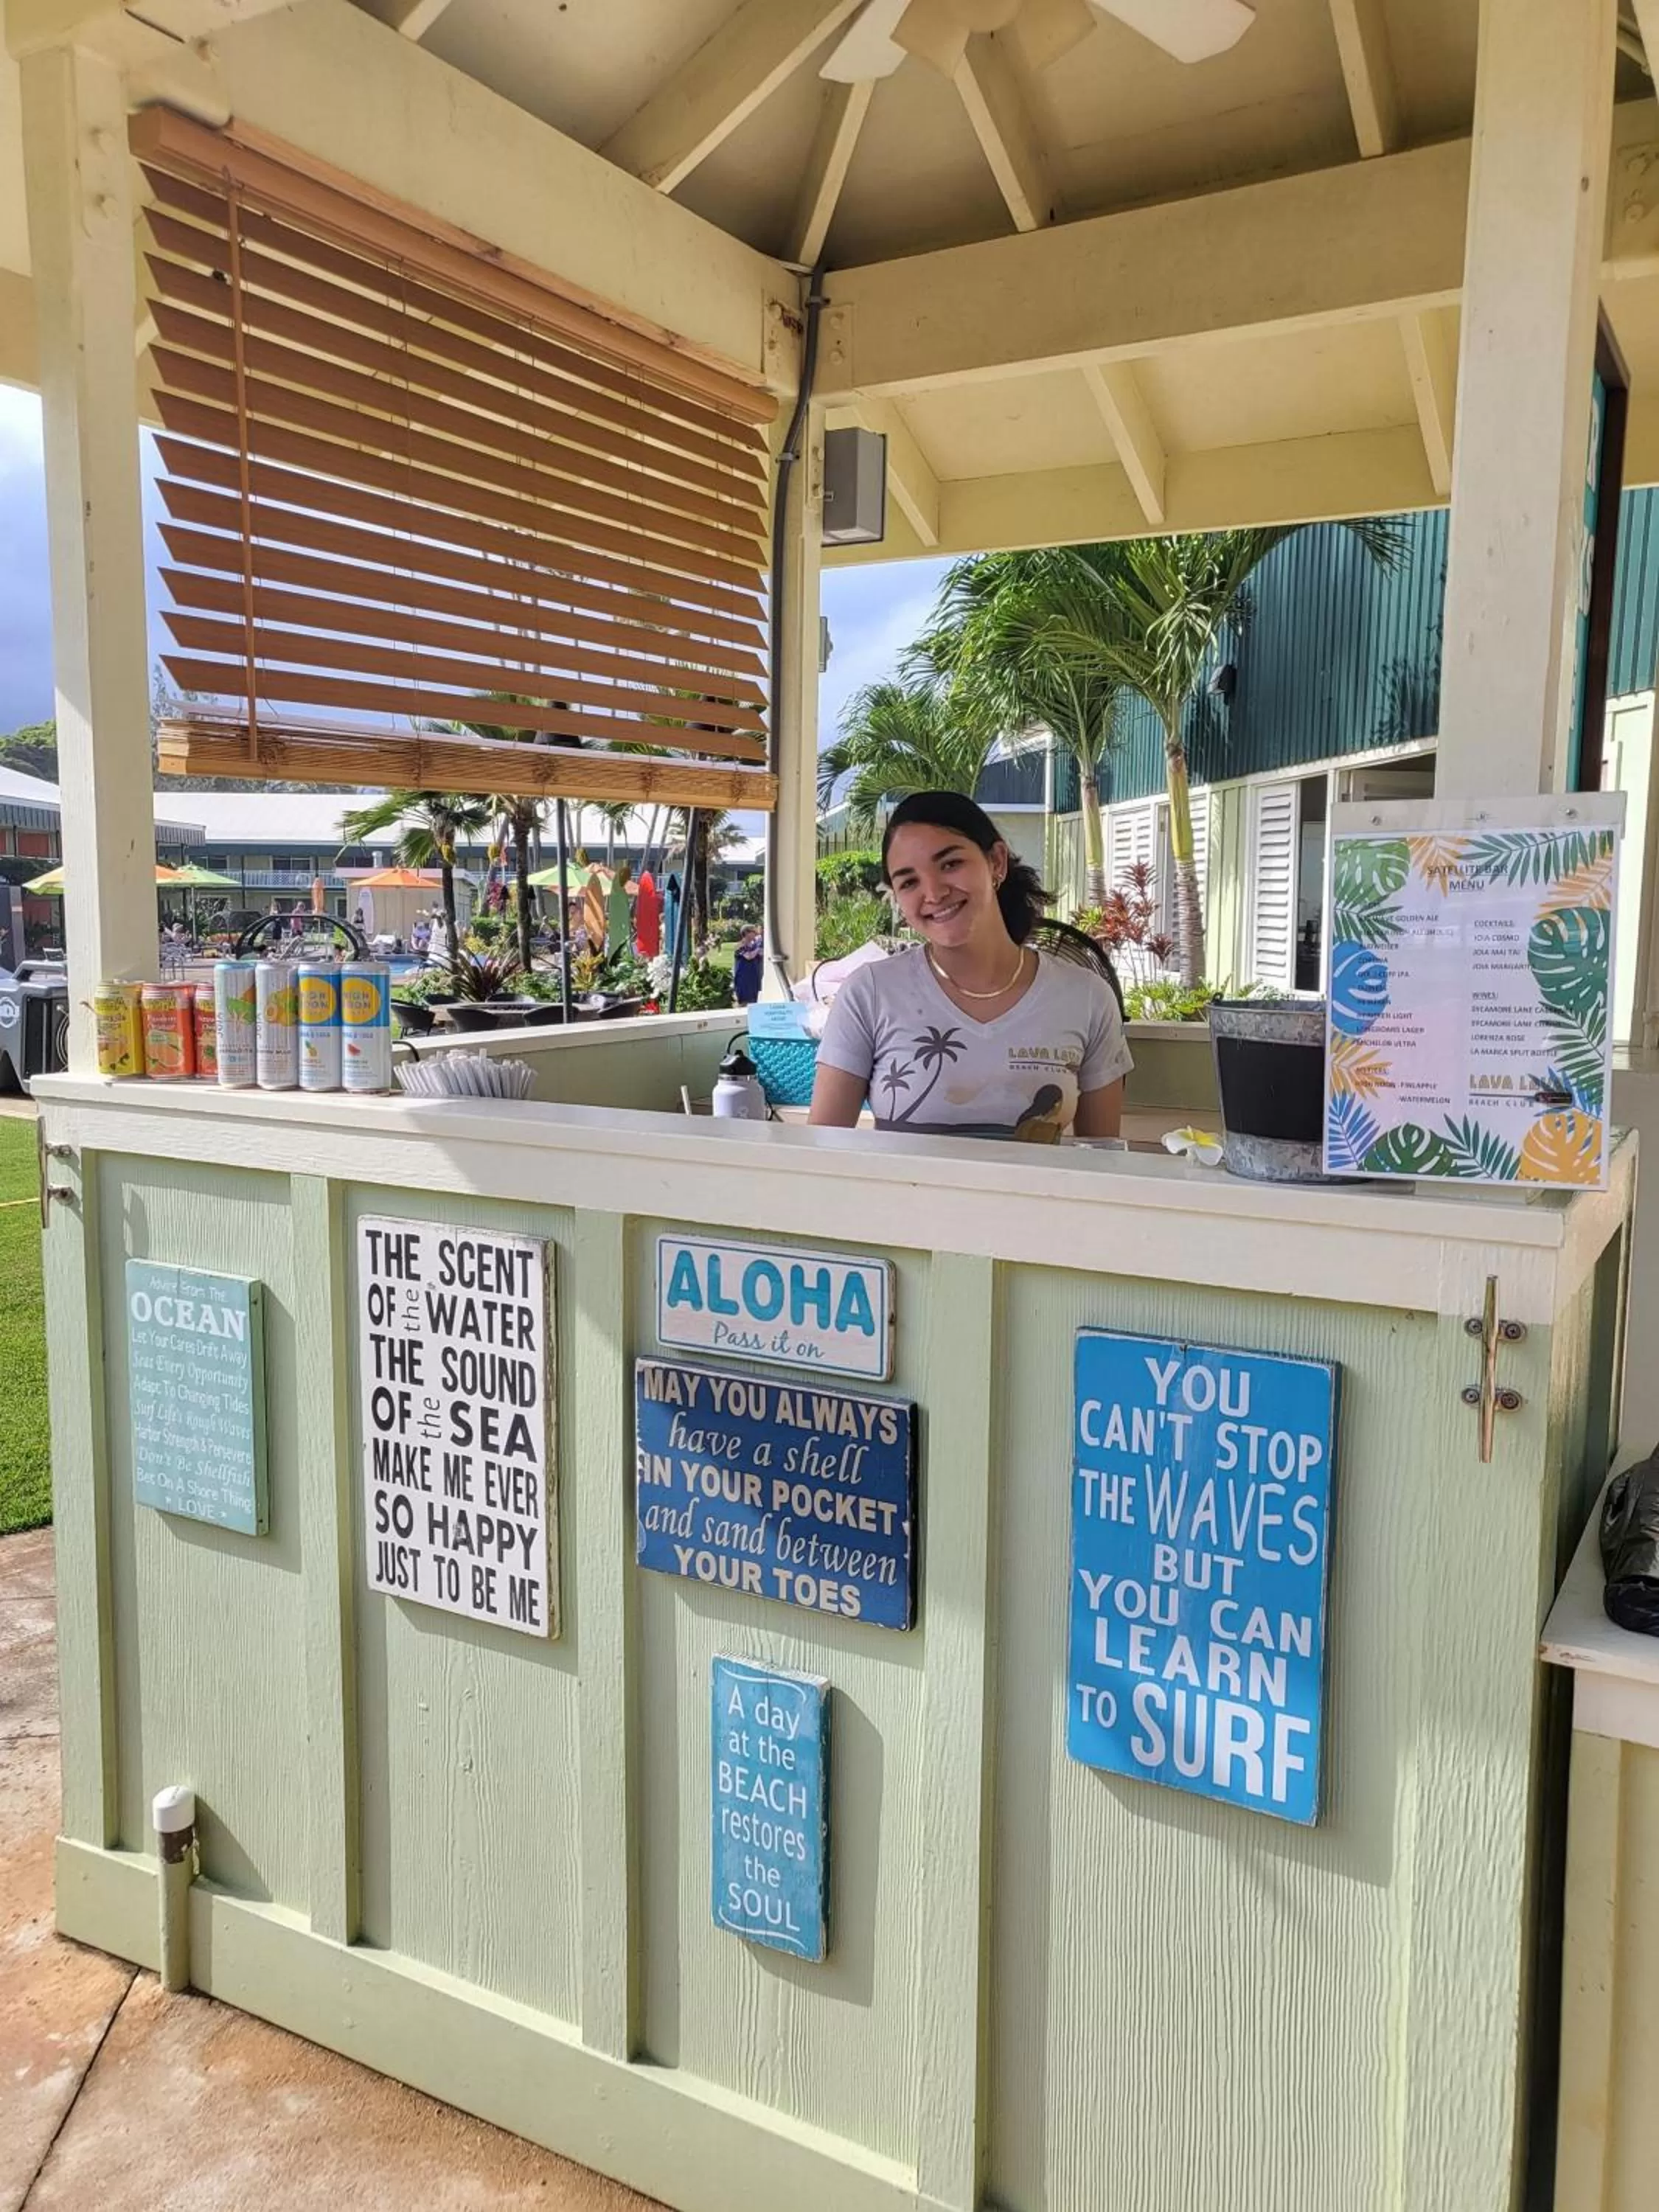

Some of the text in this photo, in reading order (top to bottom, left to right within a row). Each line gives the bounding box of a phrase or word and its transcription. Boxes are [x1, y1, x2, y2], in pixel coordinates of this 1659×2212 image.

[1427, 865, 1508, 875] SATELLITE BAR
[1450, 880, 1484, 891] MENU
[1009, 1047, 1049, 1059] LAVA
[1470, 1074, 1513, 1090] LAVA
[1469, 1099, 1499, 1107] BEACH
[366, 1229, 534, 1298] THE SCENT
[667, 1250, 875, 1337] ALOHA
[131, 1291, 246, 1342] OCEAN
[369, 1283, 396, 1328] OF
[425, 1290, 536, 1352] WATER
[713, 1321, 826, 1359] Pass it on
[148, 1329, 169, 1348] Your
[170, 1334, 195, 1354] Cares
[220, 1344, 247, 1369] Away
[188, 1362, 248, 1395] Opportunity
[369, 1332, 536, 1408] THE SOUND
[134, 1399, 157, 1422] Surf
[162, 1380, 176, 1398] To
[178, 1384, 220, 1413] Changing
[220, 1393, 248, 1415] Tides
[643, 1366, 899, 1445] MAY YOU ALWAYS
[1144, 1357, 1251, 1417] YOU
[372, 1386, 411, 1435] OF
[450, 1400, 538, 1463] SEA
[668, 1411, 870, 1485] have a shell
[1079, 1399, 1323, 1484] CAN'T STOP
[157, 1472, 173, 1490] On
[221, 1488, 251, 1514] Thing
[372, 1437, 539, 1519] MAKE ME EVER
[680, 1459, 764, 1509] YOUR
[772, 1478, 898, 1537] POCKET
[178, 1497, 216, 1520] LOVE
[375, 1489, 538, 1571] SO HAPPY
[1079, 1463, 1319, 1565] THE WAVES
[645, 1496, 897, 1587] and sand between
[1154, 1543, 1245, 1596] BUT
[375, 1540, 540, 1627] JUST TO BE ME
[673, 1544, 862, 1618] YOUR TOES
[1078, 1568, 1312, 1658] YOU CAN
[1094, 1616, 1287, 1708] LEARN
[728, 1686, 801, 1741] A day
[1076, 1681, 1311, 1804] TO SURF
[728, 1730, 796, 1770] at the
[719, 1760, 807, 1820] BEACH
[721, 1806, 806, 1862] restores
[743, 1856, 782, 1889] the
[728, 1881, 801, 1933] SOUL
